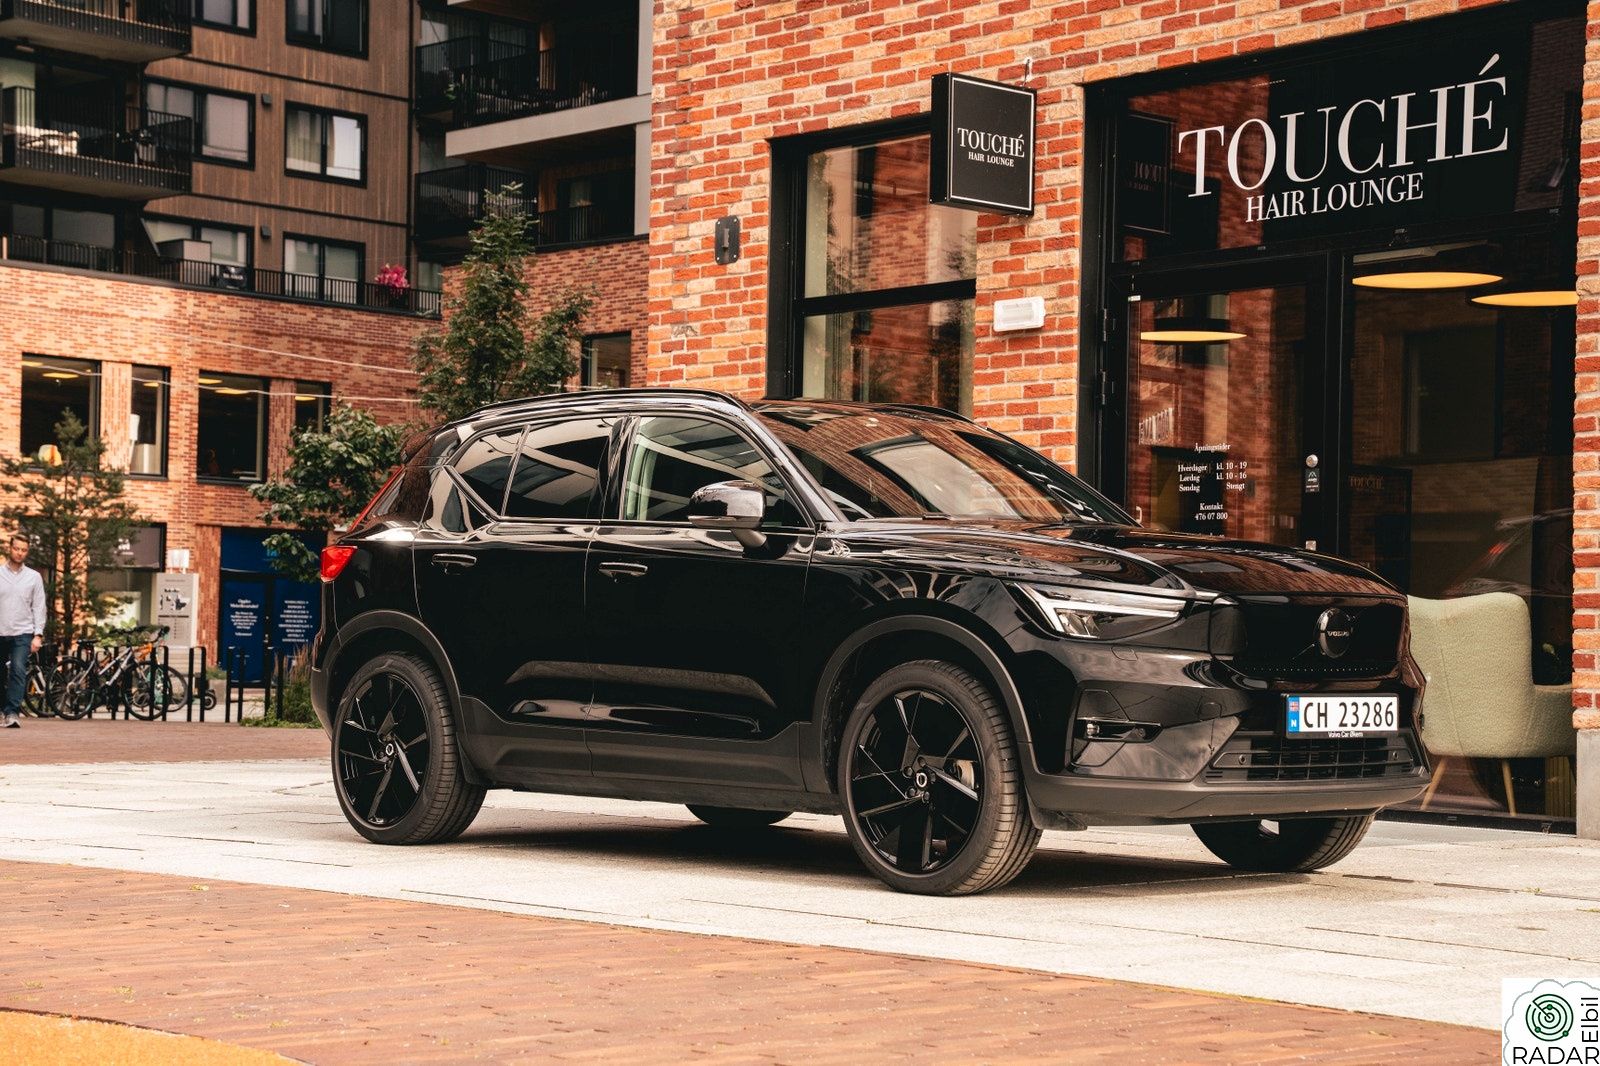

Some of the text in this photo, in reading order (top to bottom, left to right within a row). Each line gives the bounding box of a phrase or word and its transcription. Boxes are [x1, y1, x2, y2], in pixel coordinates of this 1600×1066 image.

[1178, 53, 1508, 198] TOUCHÉ
[957, 127, 1025, 158] TOUCHÉ
[968, 151, 1015, 168] HAIR LOUNGE
[1245, 173, 1424, 222] HAIR LOUNGE
[1194, 442, 1231, 453] Åpningstider
[1177, 464, 1208, 473] Hverdager
[1216, 462, 1224, 470] kl.
[1226, 462, 1234, 470] 10
[1239, 461, 1248, 469] 19
[1216, 472, 1224, 480] kl.
[1226, 472, 1234, 480] 10
[1239, 471, 1247, 479] 16
[1226, 482, 1245, 491] Stengt
[1200, 502, 1224, 511] Kontakt
[1195, 513, 1206, 521] 476
[1216, 512, 1228, 520] 800
[1303, 701, 1394, 728] CH 23286
[1291, 719, 1297, 728] N
[1328, 730, 1340, 738] Volvo
